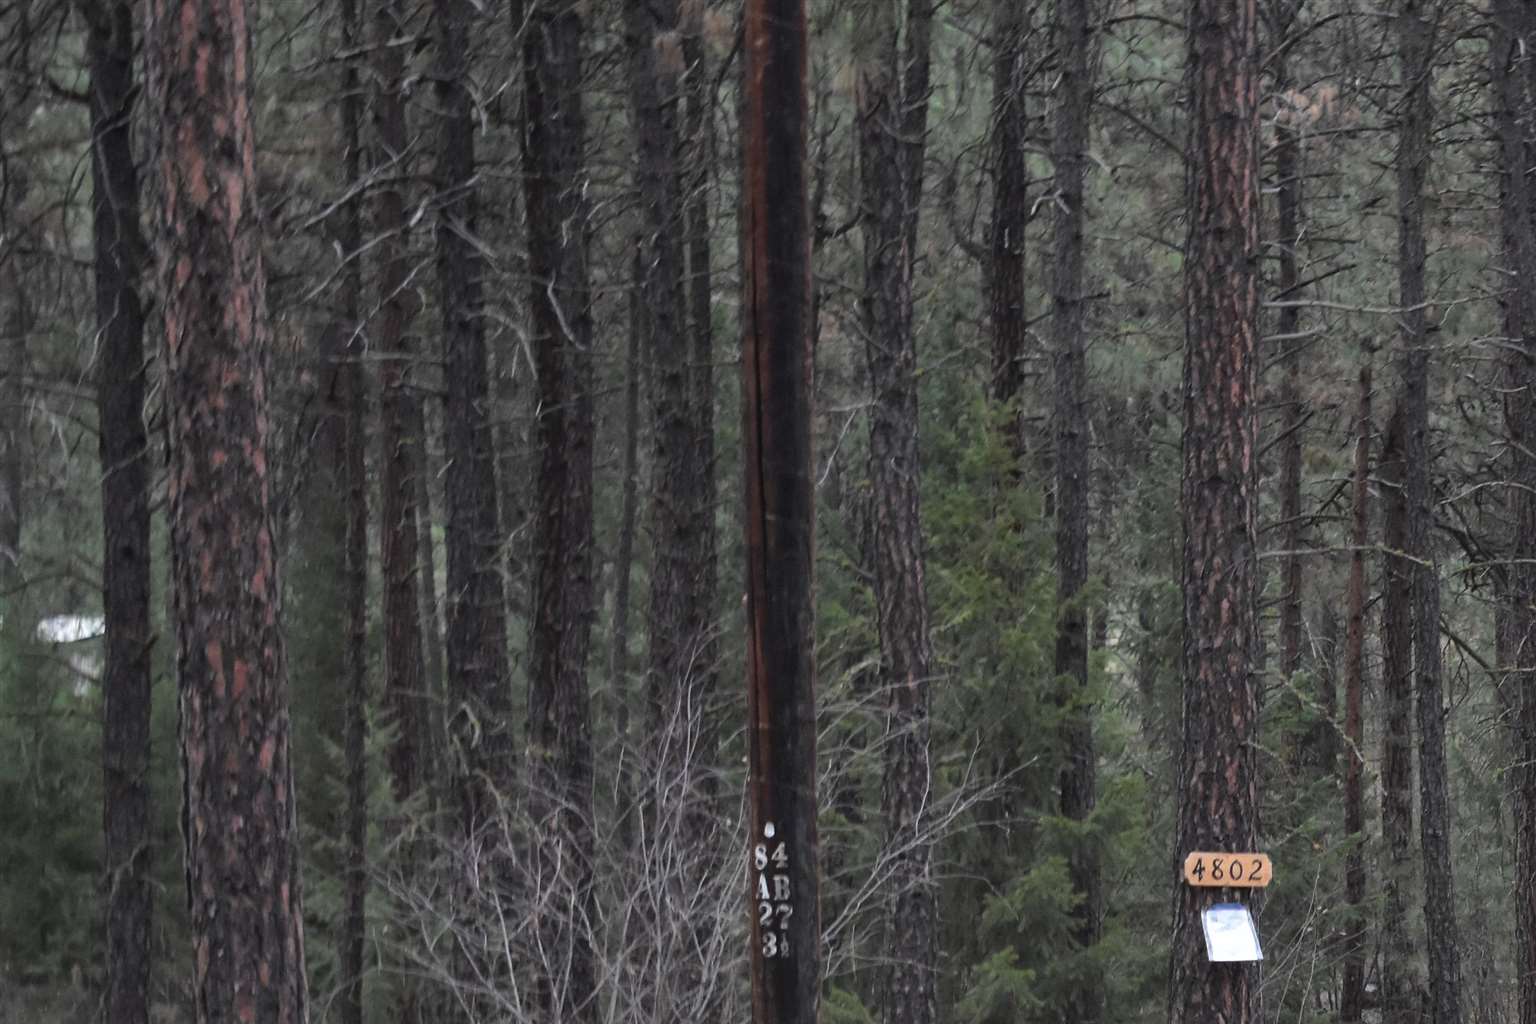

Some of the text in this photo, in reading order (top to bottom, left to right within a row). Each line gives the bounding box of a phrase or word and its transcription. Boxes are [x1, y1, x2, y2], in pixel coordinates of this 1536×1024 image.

[755, 841, 788, 870] 84
[1192, 858, 1262, 882] 4802
[756, 872, 790, 901] AB
[759, 901, 793, 930] 27
